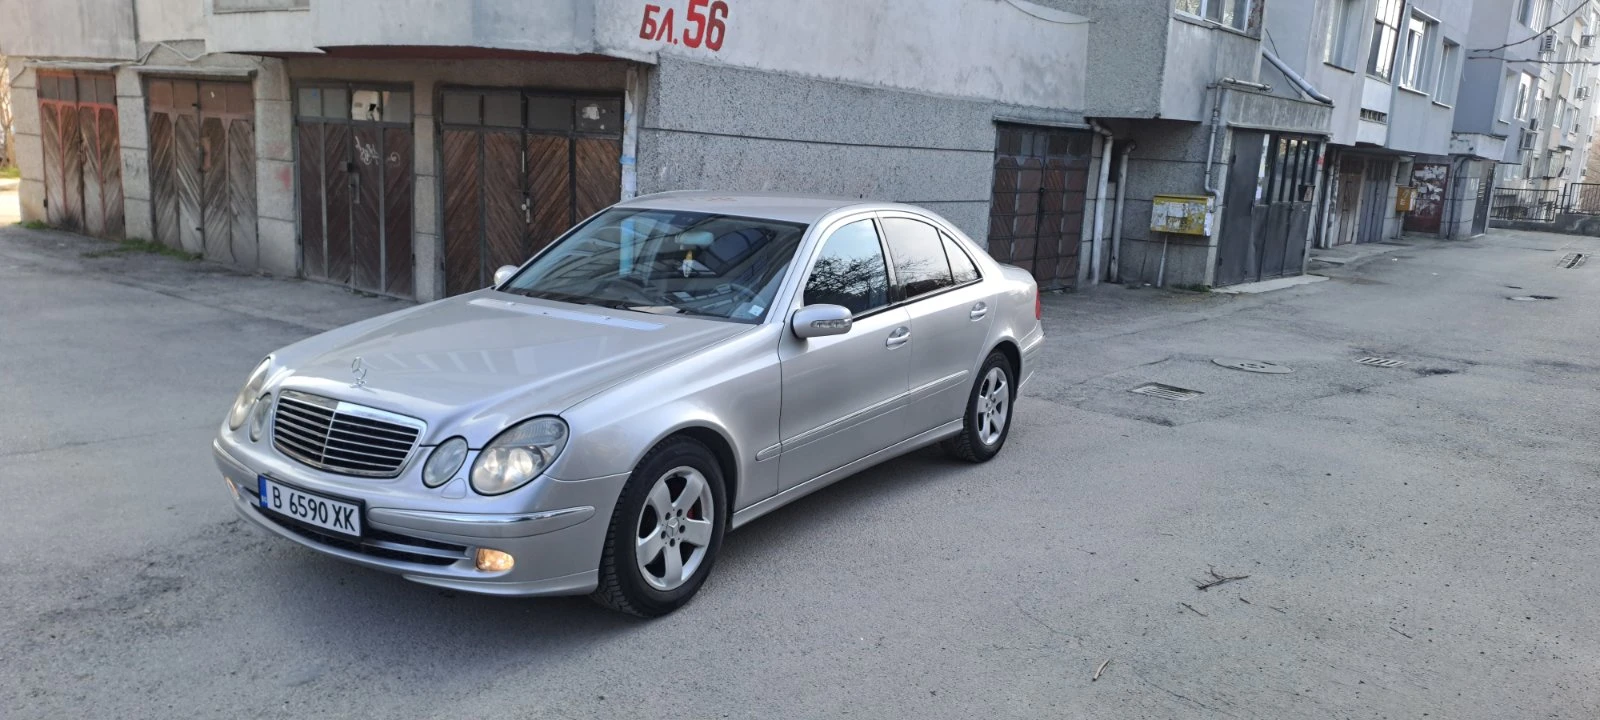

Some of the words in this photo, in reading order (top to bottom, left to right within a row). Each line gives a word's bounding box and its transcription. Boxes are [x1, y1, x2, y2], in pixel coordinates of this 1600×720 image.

[683, 0, 729, 51] 56
[272, 486, 282, 509] B
[289, 492, 328, 524] 6590
[332, 503, 356, 532] XK
